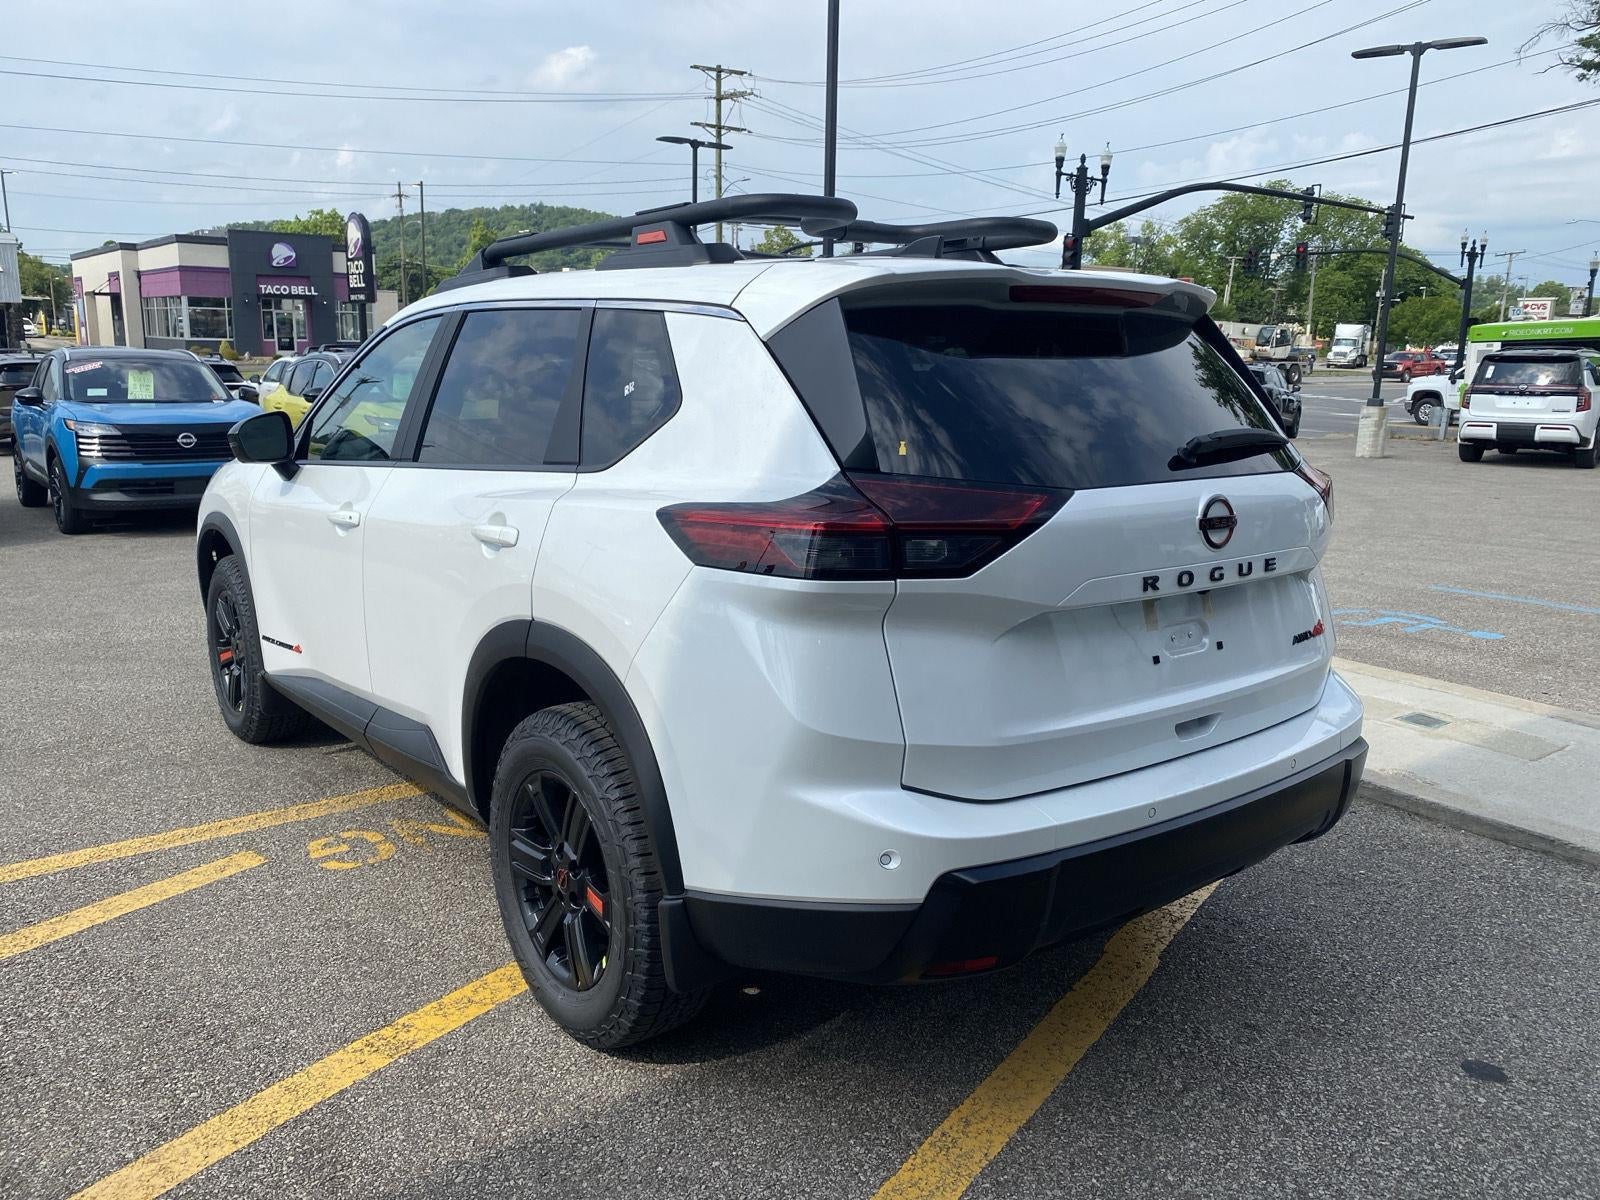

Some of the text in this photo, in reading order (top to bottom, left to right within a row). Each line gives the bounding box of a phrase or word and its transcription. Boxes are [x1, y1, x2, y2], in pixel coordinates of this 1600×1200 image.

[348, 261, 364, 274] TACO
[349, 274, 365, 287] BELL
[259, 284, 318, 296] TACO BELL
[1142, 557, 1277, 592] ROGUE
